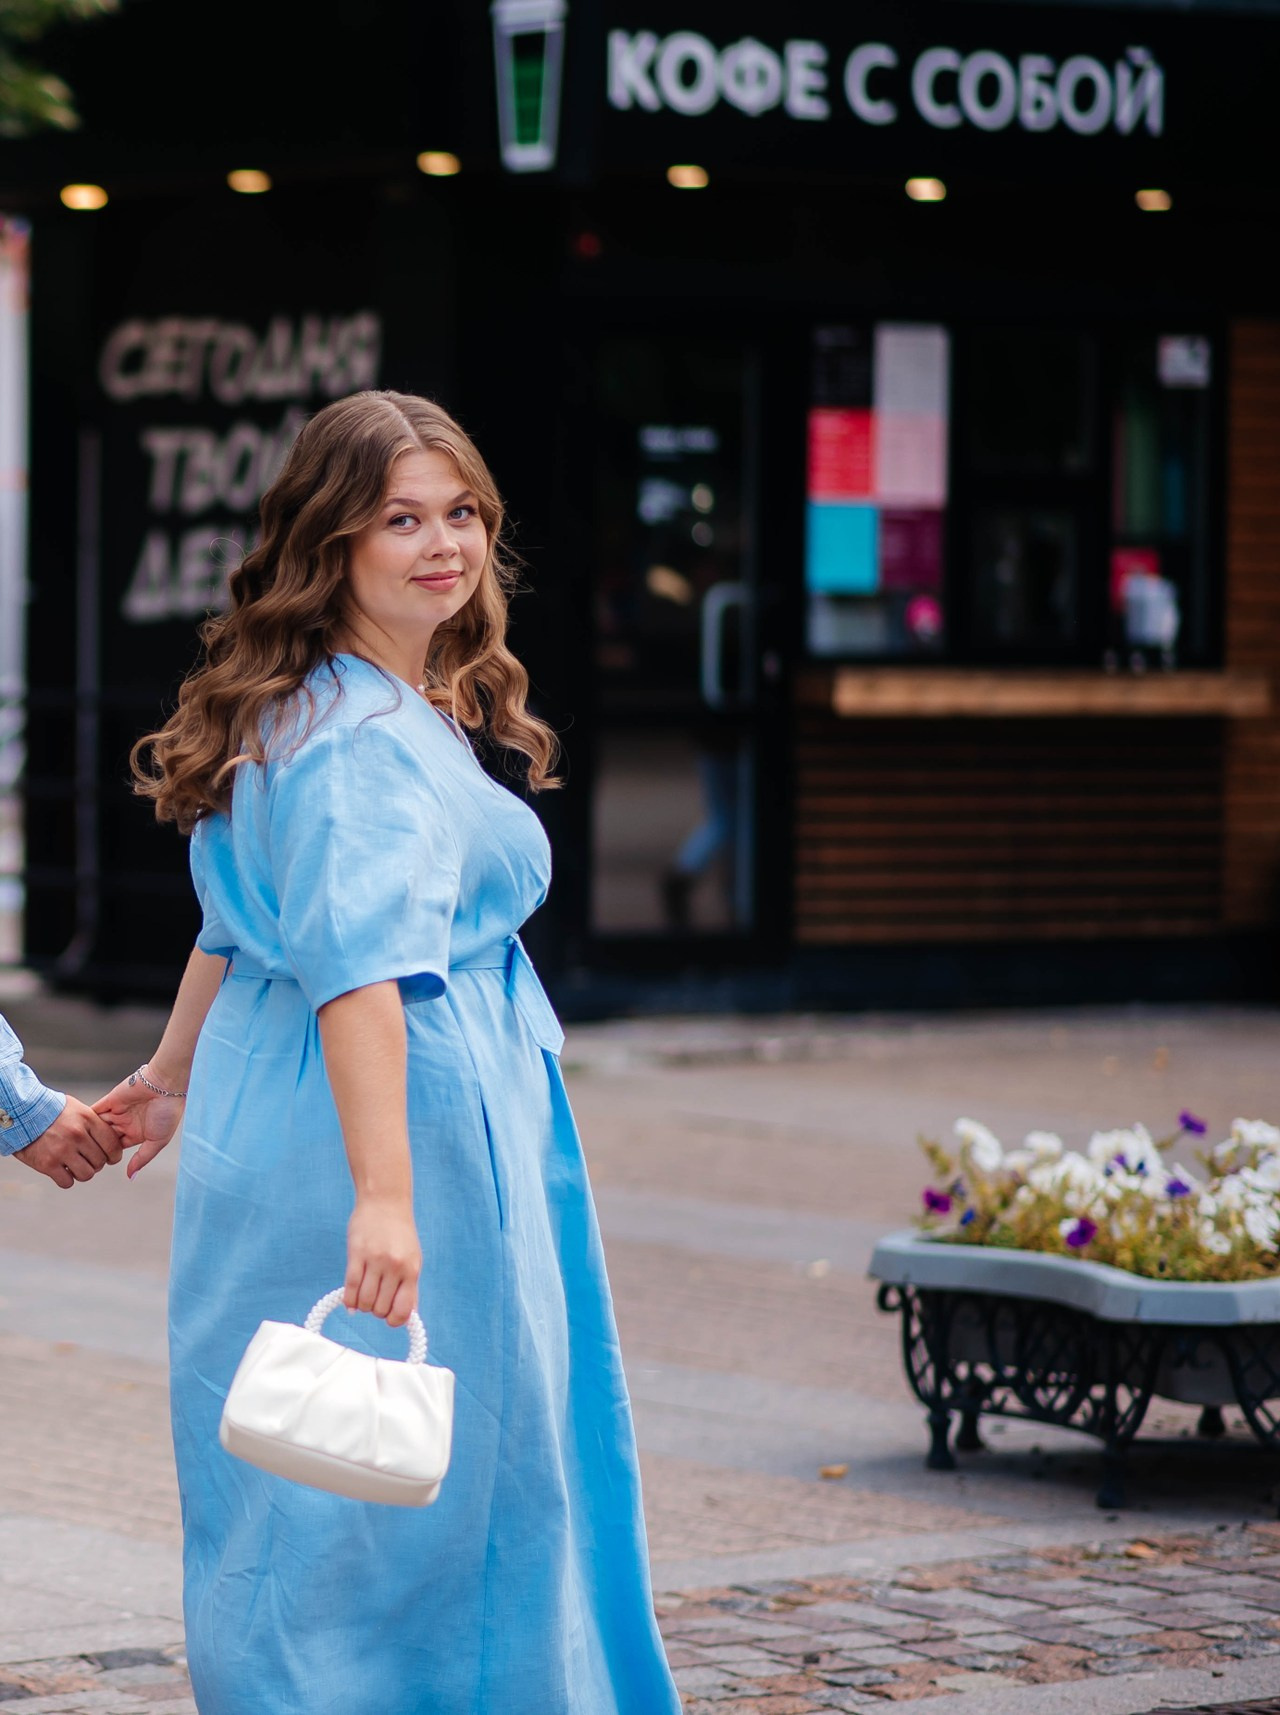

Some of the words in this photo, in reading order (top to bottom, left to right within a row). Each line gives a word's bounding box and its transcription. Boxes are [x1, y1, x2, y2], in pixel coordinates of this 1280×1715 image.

[608, 29, 829, 116] КОФЕ
[845, 42, 898, 125] С
[912, 45, 1165, 137] СОБОЙ
[100, 311, 381, 402] СЕГОДНЯ
